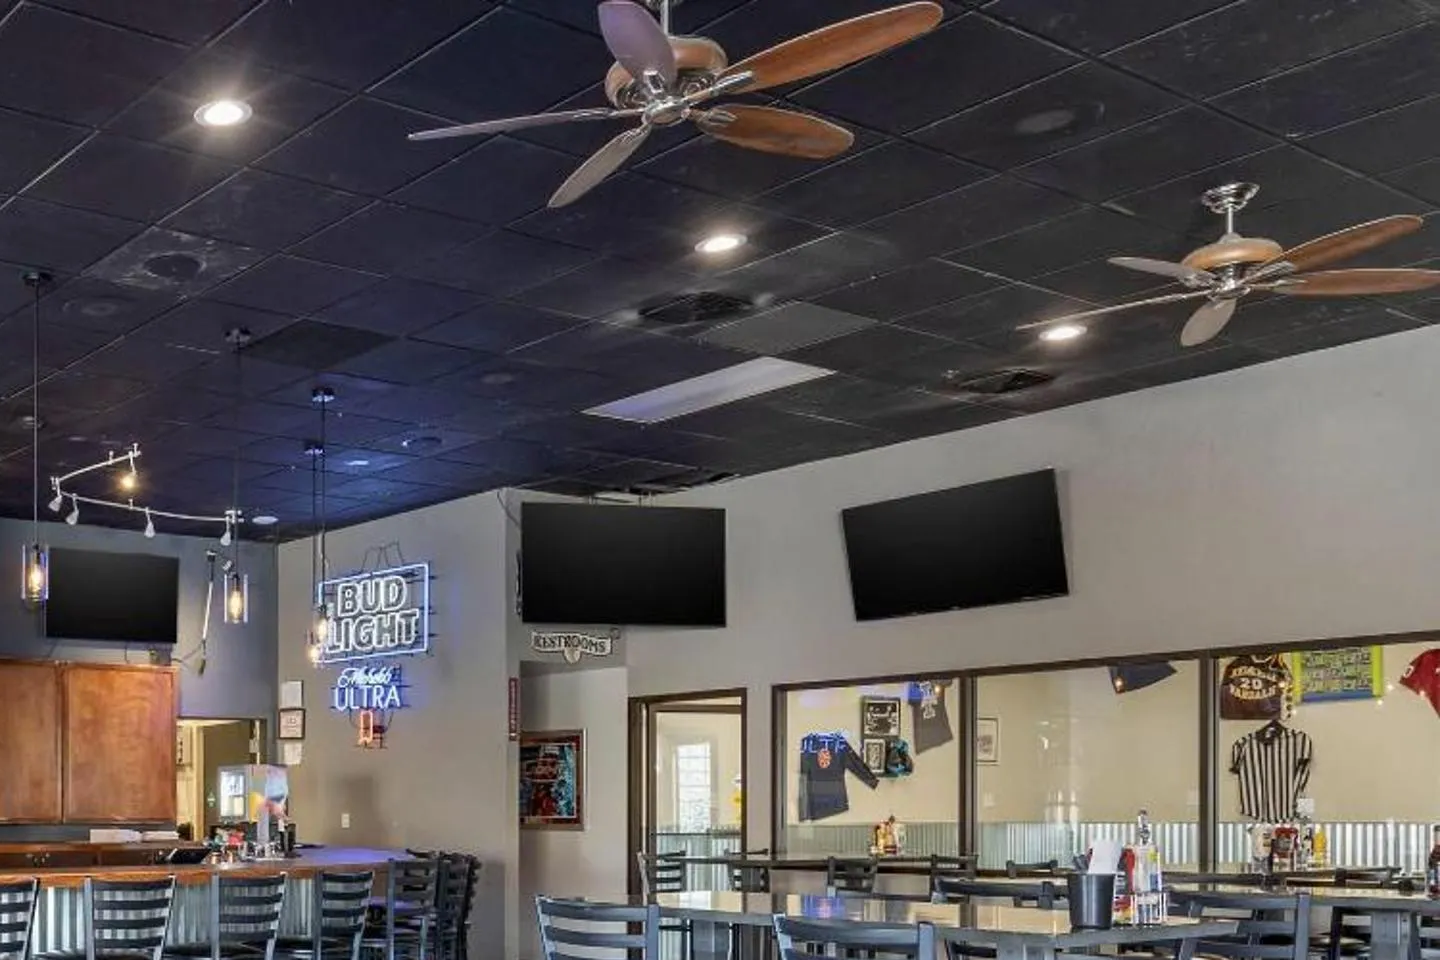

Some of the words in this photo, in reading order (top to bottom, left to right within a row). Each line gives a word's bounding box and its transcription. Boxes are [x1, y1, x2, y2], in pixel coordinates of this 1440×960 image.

[337, 575, 408, 618] BUD
[326, 608, 420, 655] LIGHT
[533, 635, 607, 653] RESTROOMS
[1239, 677, 1263, 690] 20
[335, 684, 401, 711] ULTRA
